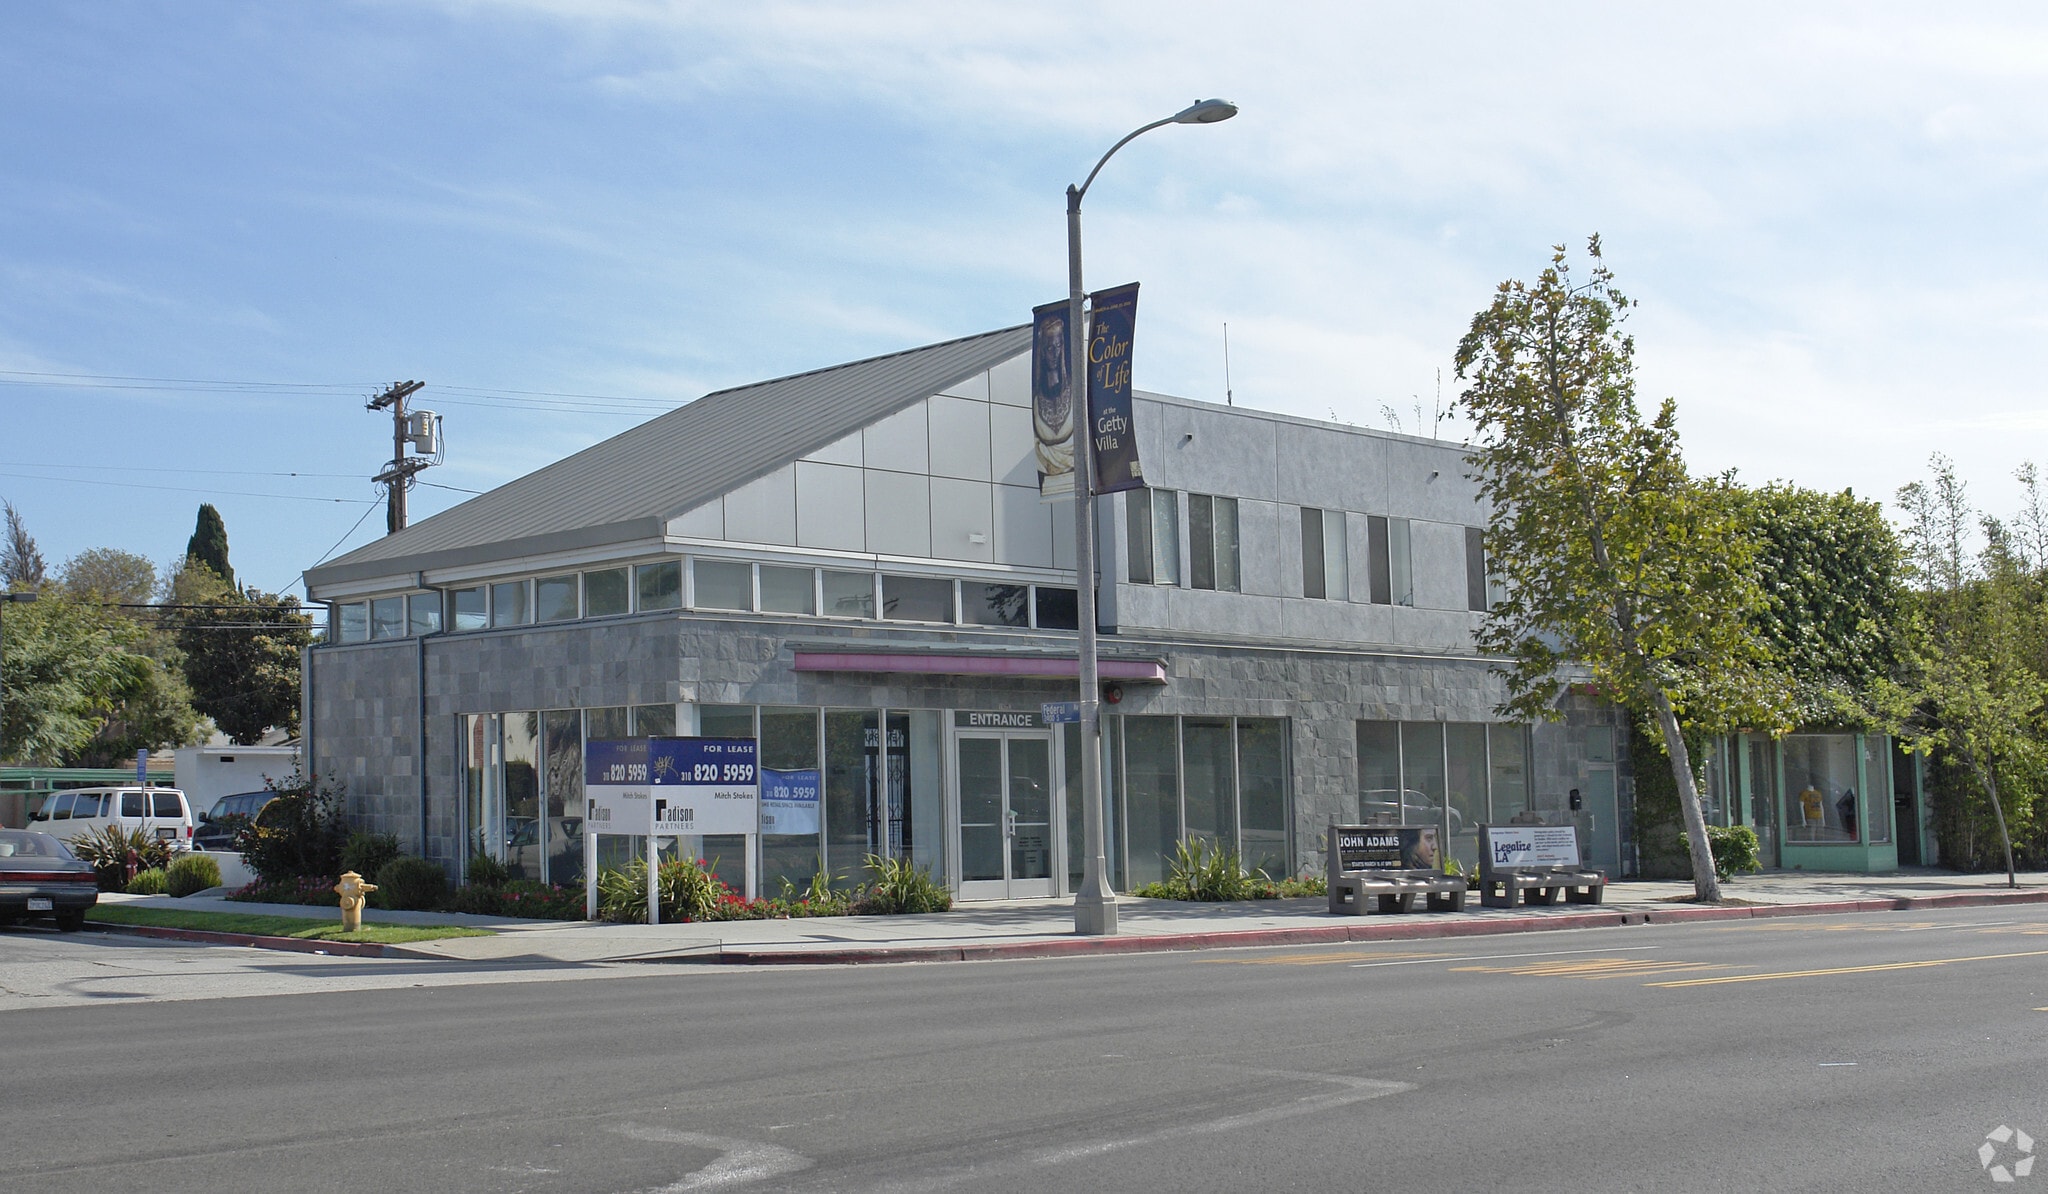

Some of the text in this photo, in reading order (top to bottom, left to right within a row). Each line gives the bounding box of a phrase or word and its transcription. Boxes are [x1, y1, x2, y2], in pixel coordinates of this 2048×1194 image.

[1096, 322, 1109, 335] The
[1090, 334, 1128, 363] Color
[1097, 360, 1130, 394] of Life
[1108, 406, 1116, 414] the
[1098, 415, 1127, 434] Getty
[1096, 434, 1118, 452] Villa
[1043, 704, 1065, 715] Federal
[970, 713, 1032, 726] ENTRANCE
[703, 745, 722, 753] FOR
[681, 772, 692, 781] 310
[732, 792, 753, 800] Stokes
[774, 786, 789, 798] 820
[793, 787, 815, 798] 5959
[655, 822, 694, 830] PARTNERS
[1340, 836, 1400, 847] JOHN ADAMS
[1494, 840, 1531, 854] Legalize
[1495, 852, 1509, 862] LA
